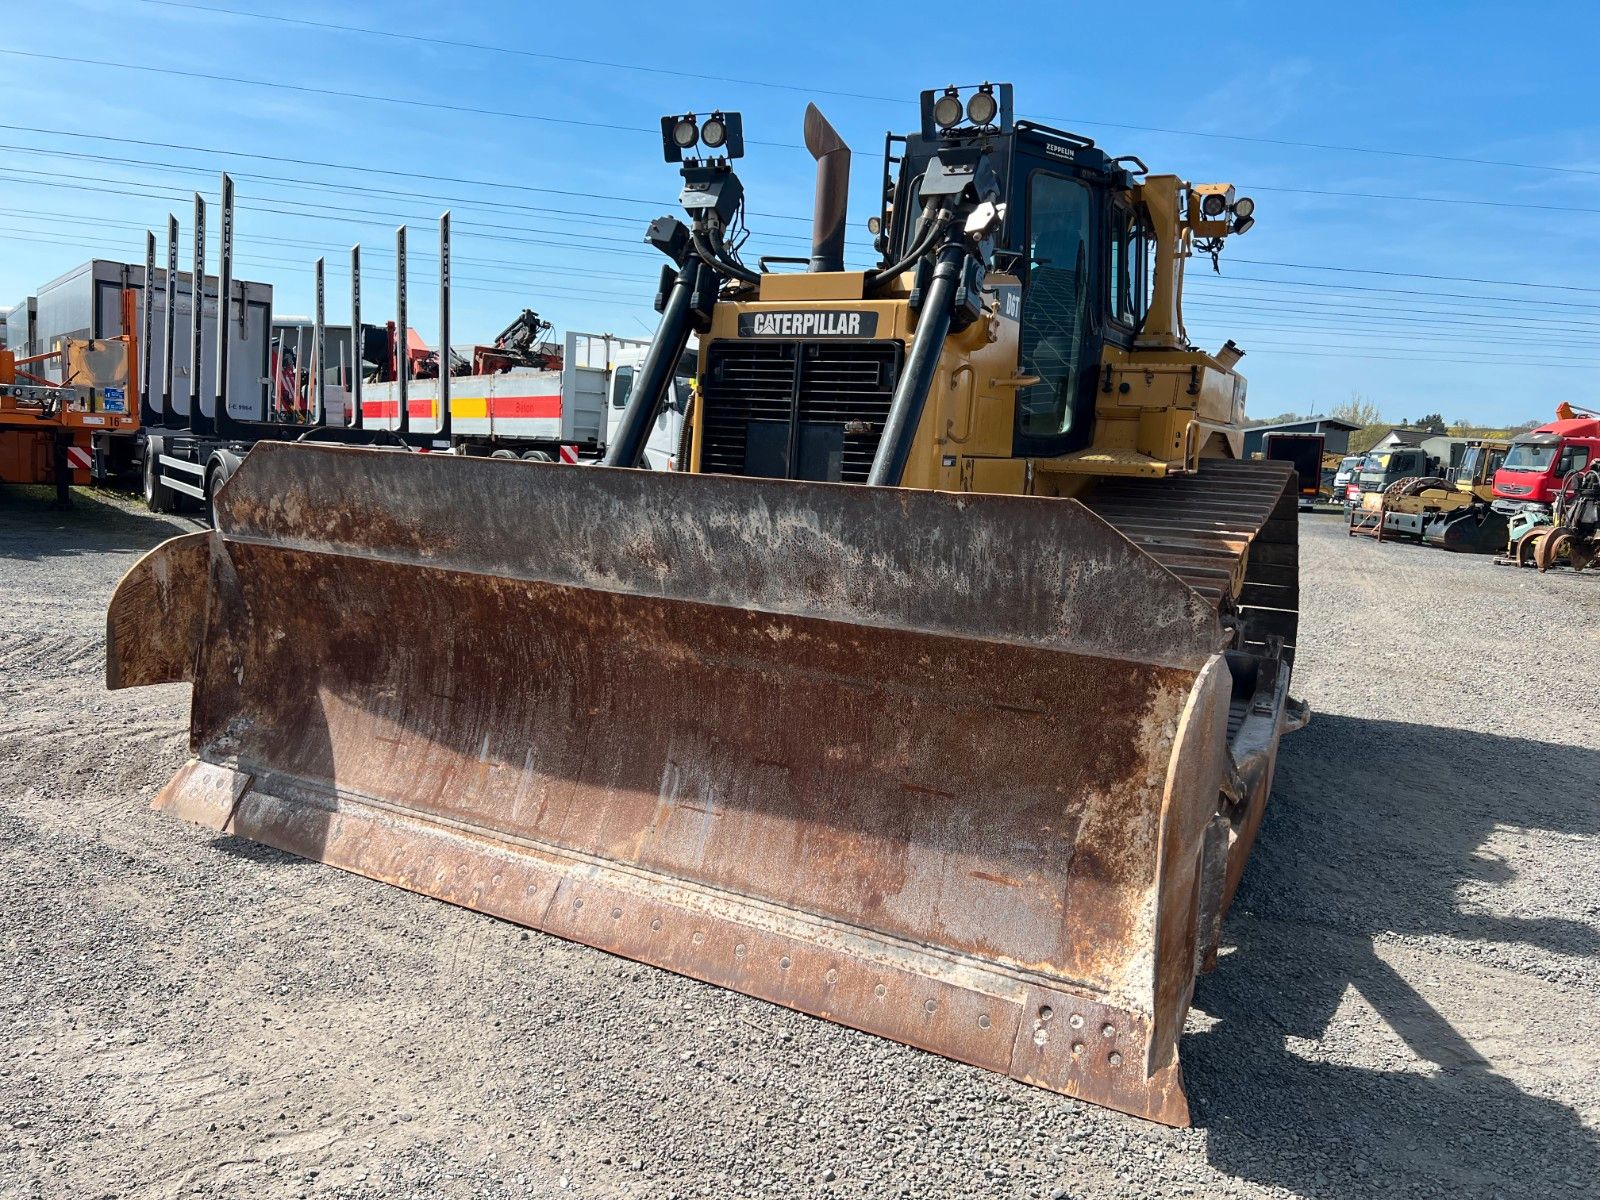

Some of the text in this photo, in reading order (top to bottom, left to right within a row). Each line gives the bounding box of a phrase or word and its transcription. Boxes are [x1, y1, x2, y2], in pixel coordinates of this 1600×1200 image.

[1046, 143, 1075, 156] ZEPPELIN
[1006, 292, 1020, 318] D6T
[753, 313, 860, 335] CATERPILLAR
[110, 416, 120, 427] 16
